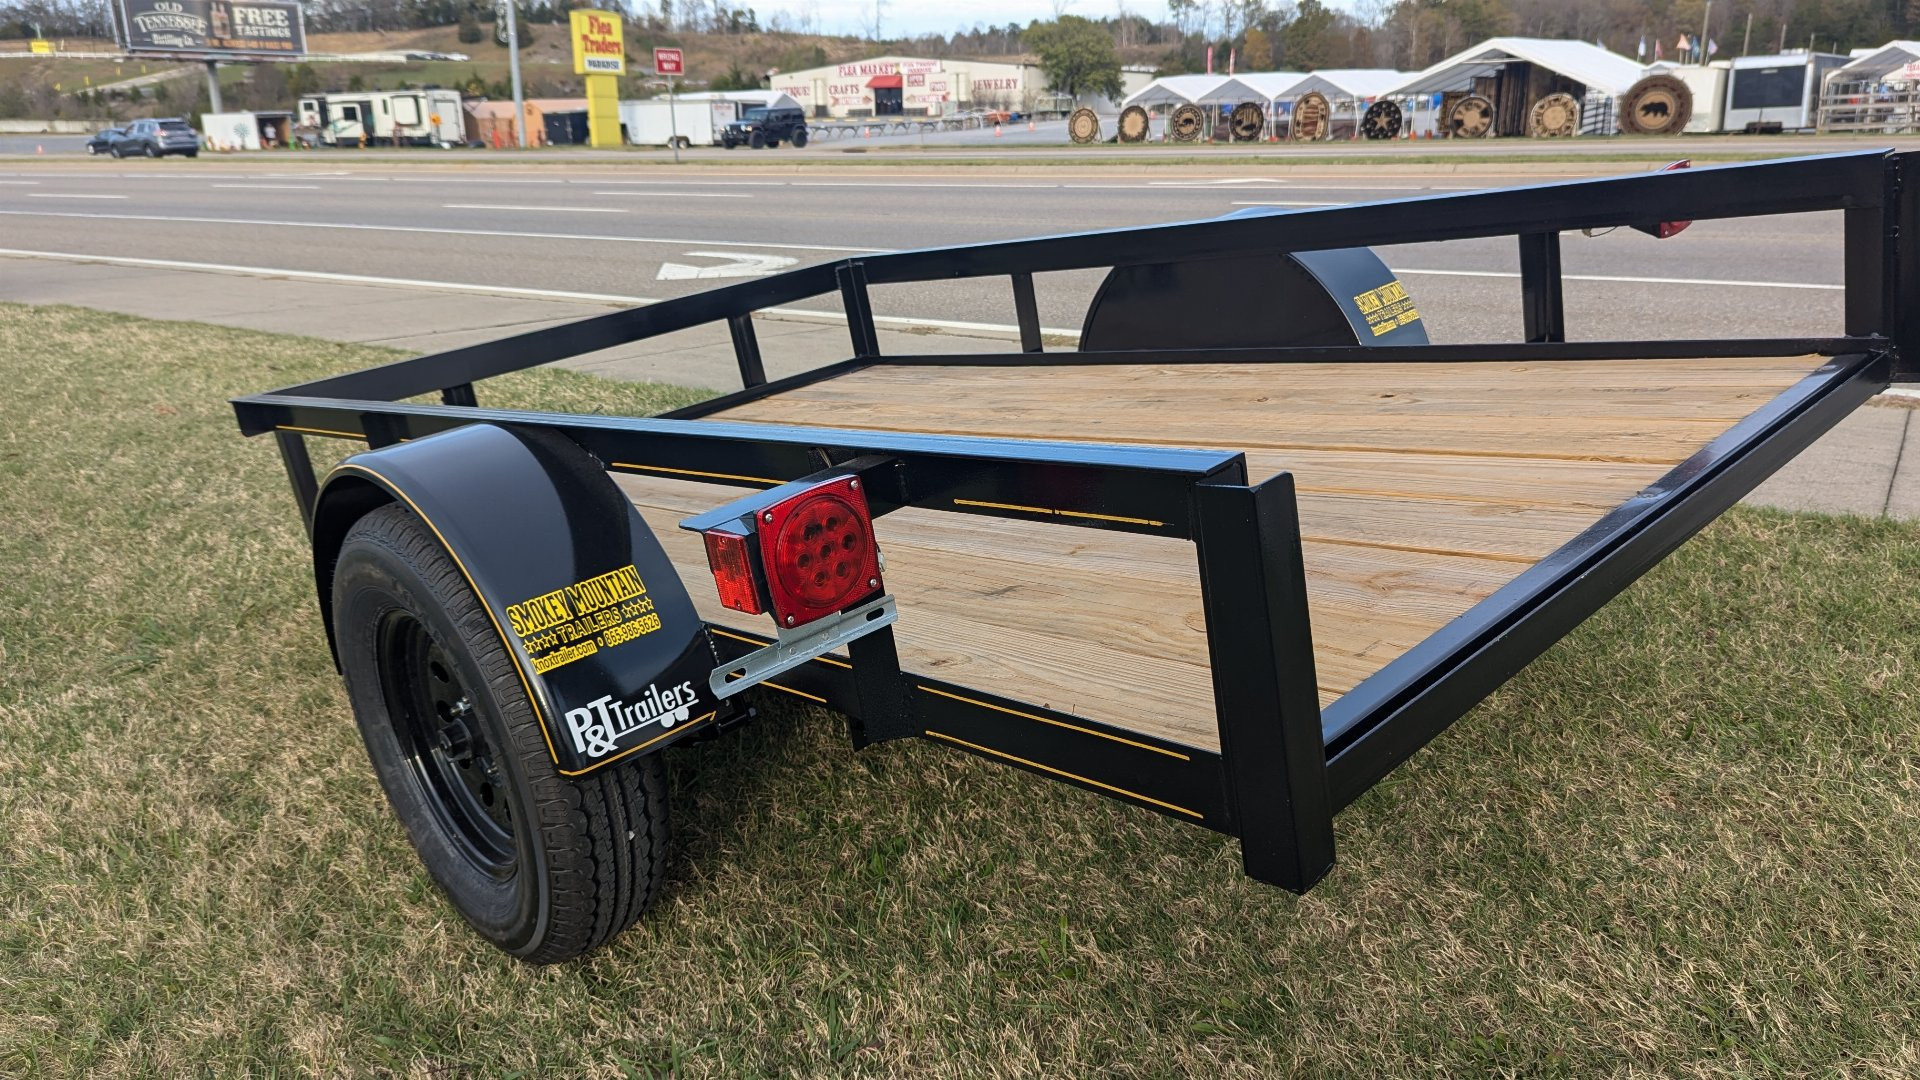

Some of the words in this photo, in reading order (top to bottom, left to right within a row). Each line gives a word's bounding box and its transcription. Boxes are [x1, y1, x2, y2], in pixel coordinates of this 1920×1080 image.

[154, 2, 183, 13] OLD
[133, 13, 207, 36] TENNESSEE
[232, 7, 289, 26] FREE
[235, 26, 291, 38] TASTINGS
[588, 15, 612, 35] Flea
[657, 52, 680, 61] WRONG
[662, 62, 677, 70] WAY
[840, 65, 857, 76] FLEA
[860, 63, 895, 75] MARKET
[829, 84, 860, 95] CRAFTS
[973, 79, 1018, 89] JEWELRY
[505, 589, 574, 638] SMOKEY
[566, 565, 647, 617] MOUNTAIN
[557, 607, 622, 643] TRAILERS
[531, 640, 597, 675] knoxtrailer.com
[604, 613, 661, 647] 865-986-5626
[609, 681, 696, 731] Trailers
